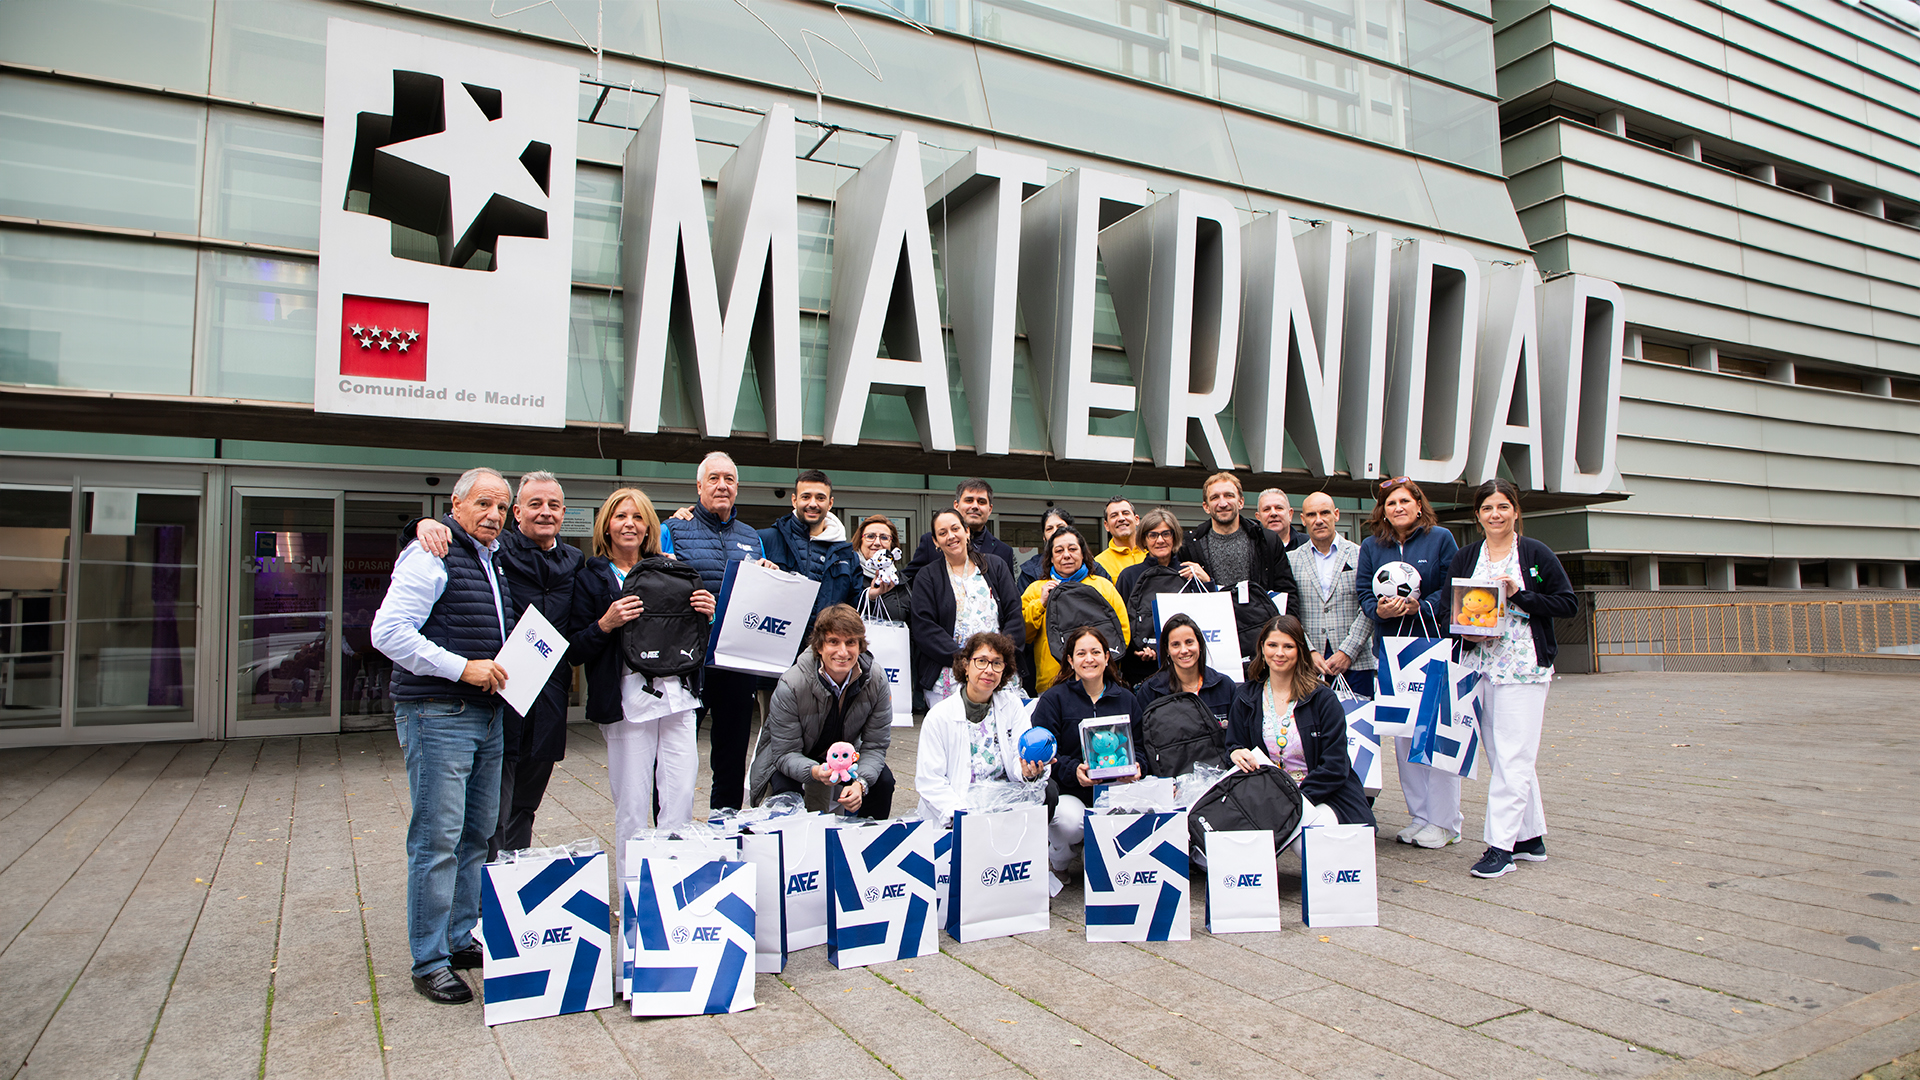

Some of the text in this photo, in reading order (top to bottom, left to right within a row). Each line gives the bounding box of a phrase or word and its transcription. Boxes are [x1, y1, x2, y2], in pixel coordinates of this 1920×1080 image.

[624, 85, 1625, 494] MATERNIDAD
[338, 379, 545, 408] Comunidad de Madrid
[358, 560, 391, 571] PASAR
[757, 616, 792, 636] AFE
[534, 639, 553, 658] AFE
[884, 668, 900, 683] FE
[999, 860, 1032, 883] AFE
[1132, 870, 1158, 884] AFE
[1336, 870, 1361, 883] AFE
[786, 870, 819, 895] AFE
[1237, 874, 1263, 887] AFE
[882, 883, 907, 899] AFE
[541, 926, 573, 945] AFE
[692, 927, 722, 941] AFE
